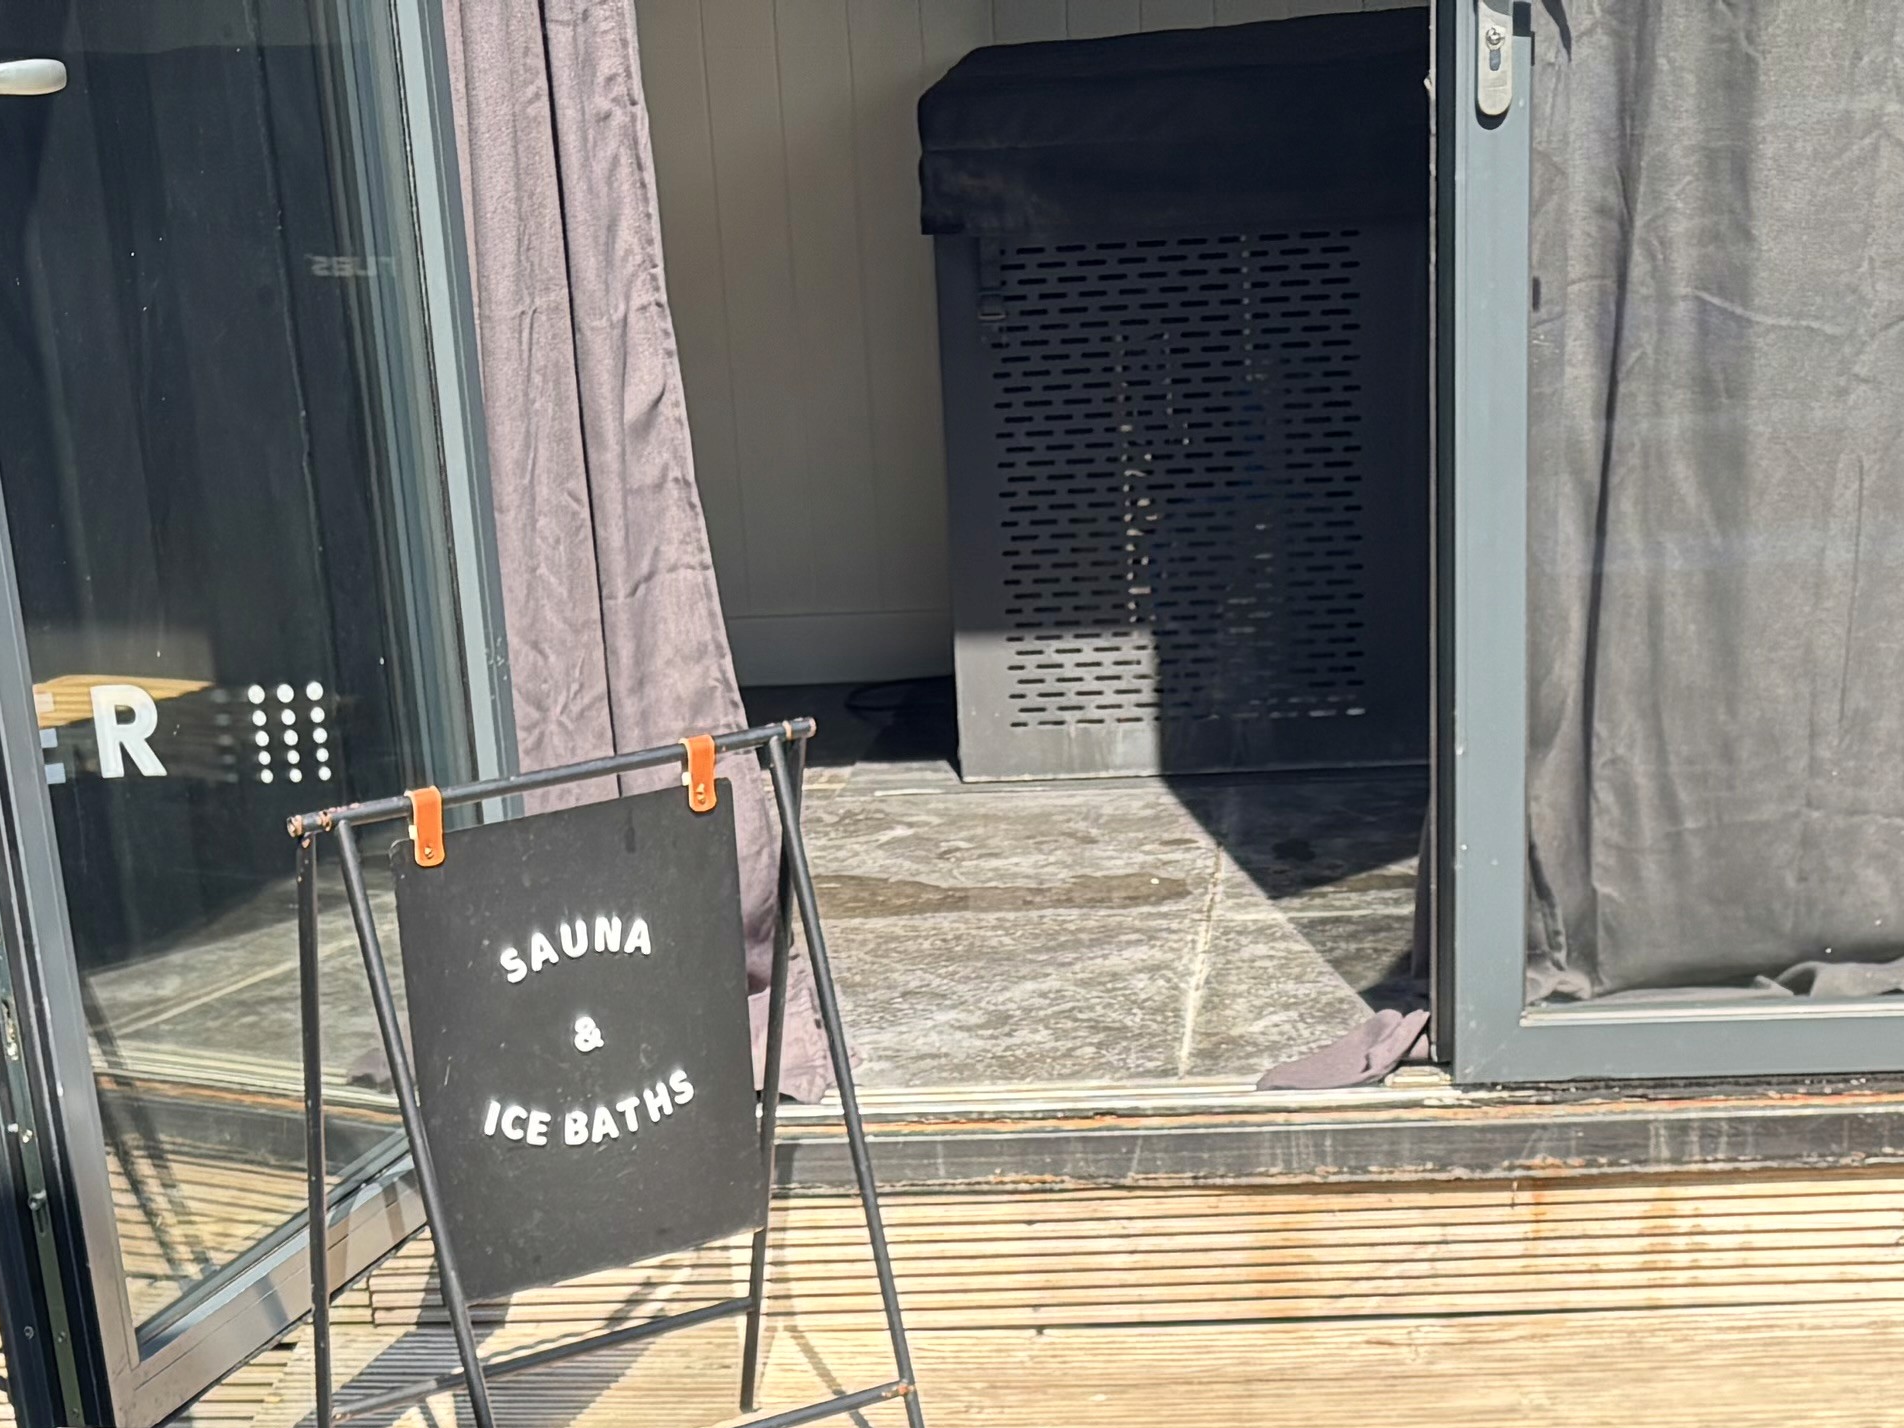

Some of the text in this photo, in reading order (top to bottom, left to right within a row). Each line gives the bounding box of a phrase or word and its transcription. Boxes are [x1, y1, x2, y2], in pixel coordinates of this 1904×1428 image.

[499, 911, 652, 984] SAUNA
[573, 1014, 605, 1053] &
[483, 1066, 696, 1146] ICE BATHS
